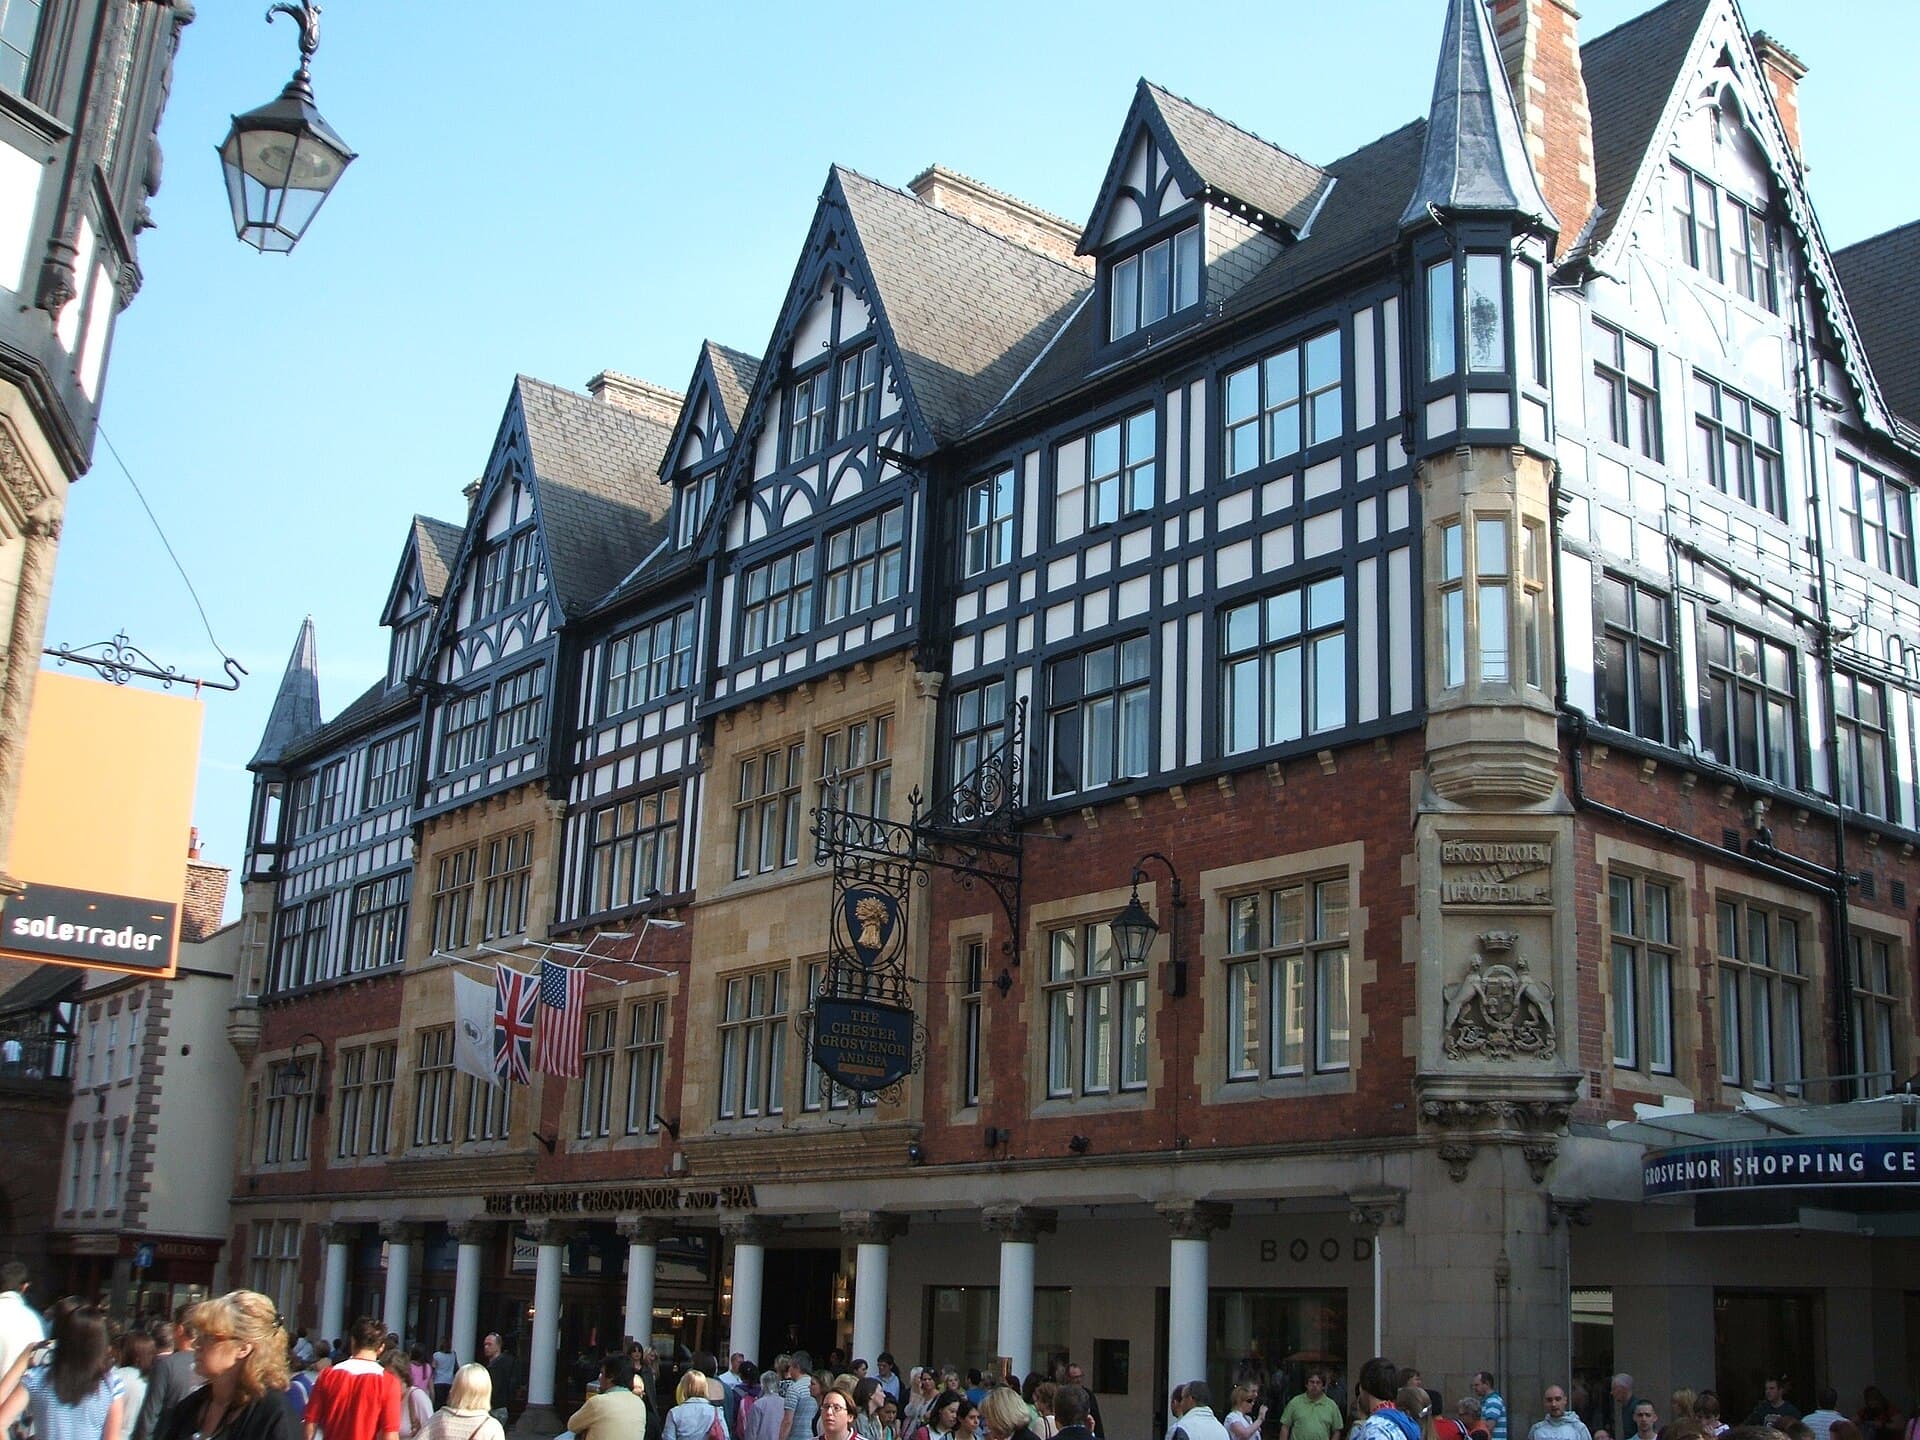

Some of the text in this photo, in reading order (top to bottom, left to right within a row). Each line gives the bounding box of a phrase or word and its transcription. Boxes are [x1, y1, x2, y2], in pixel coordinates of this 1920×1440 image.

[850, 1010, 879, 1024] THE
[831, 1022, 897, 1041] CHESTER
[820, 1034, 906, 1057] GROSVENOR
[838, 1052, 888, 1067] AND SPA
[1645, 1159, 1721, 1186] GROSVENOR
[1733, 1151, 1865, 1176] SHOPPING
[484, 1185, 756, 1214] THE CHESTER GROSVENOR AND SPA
